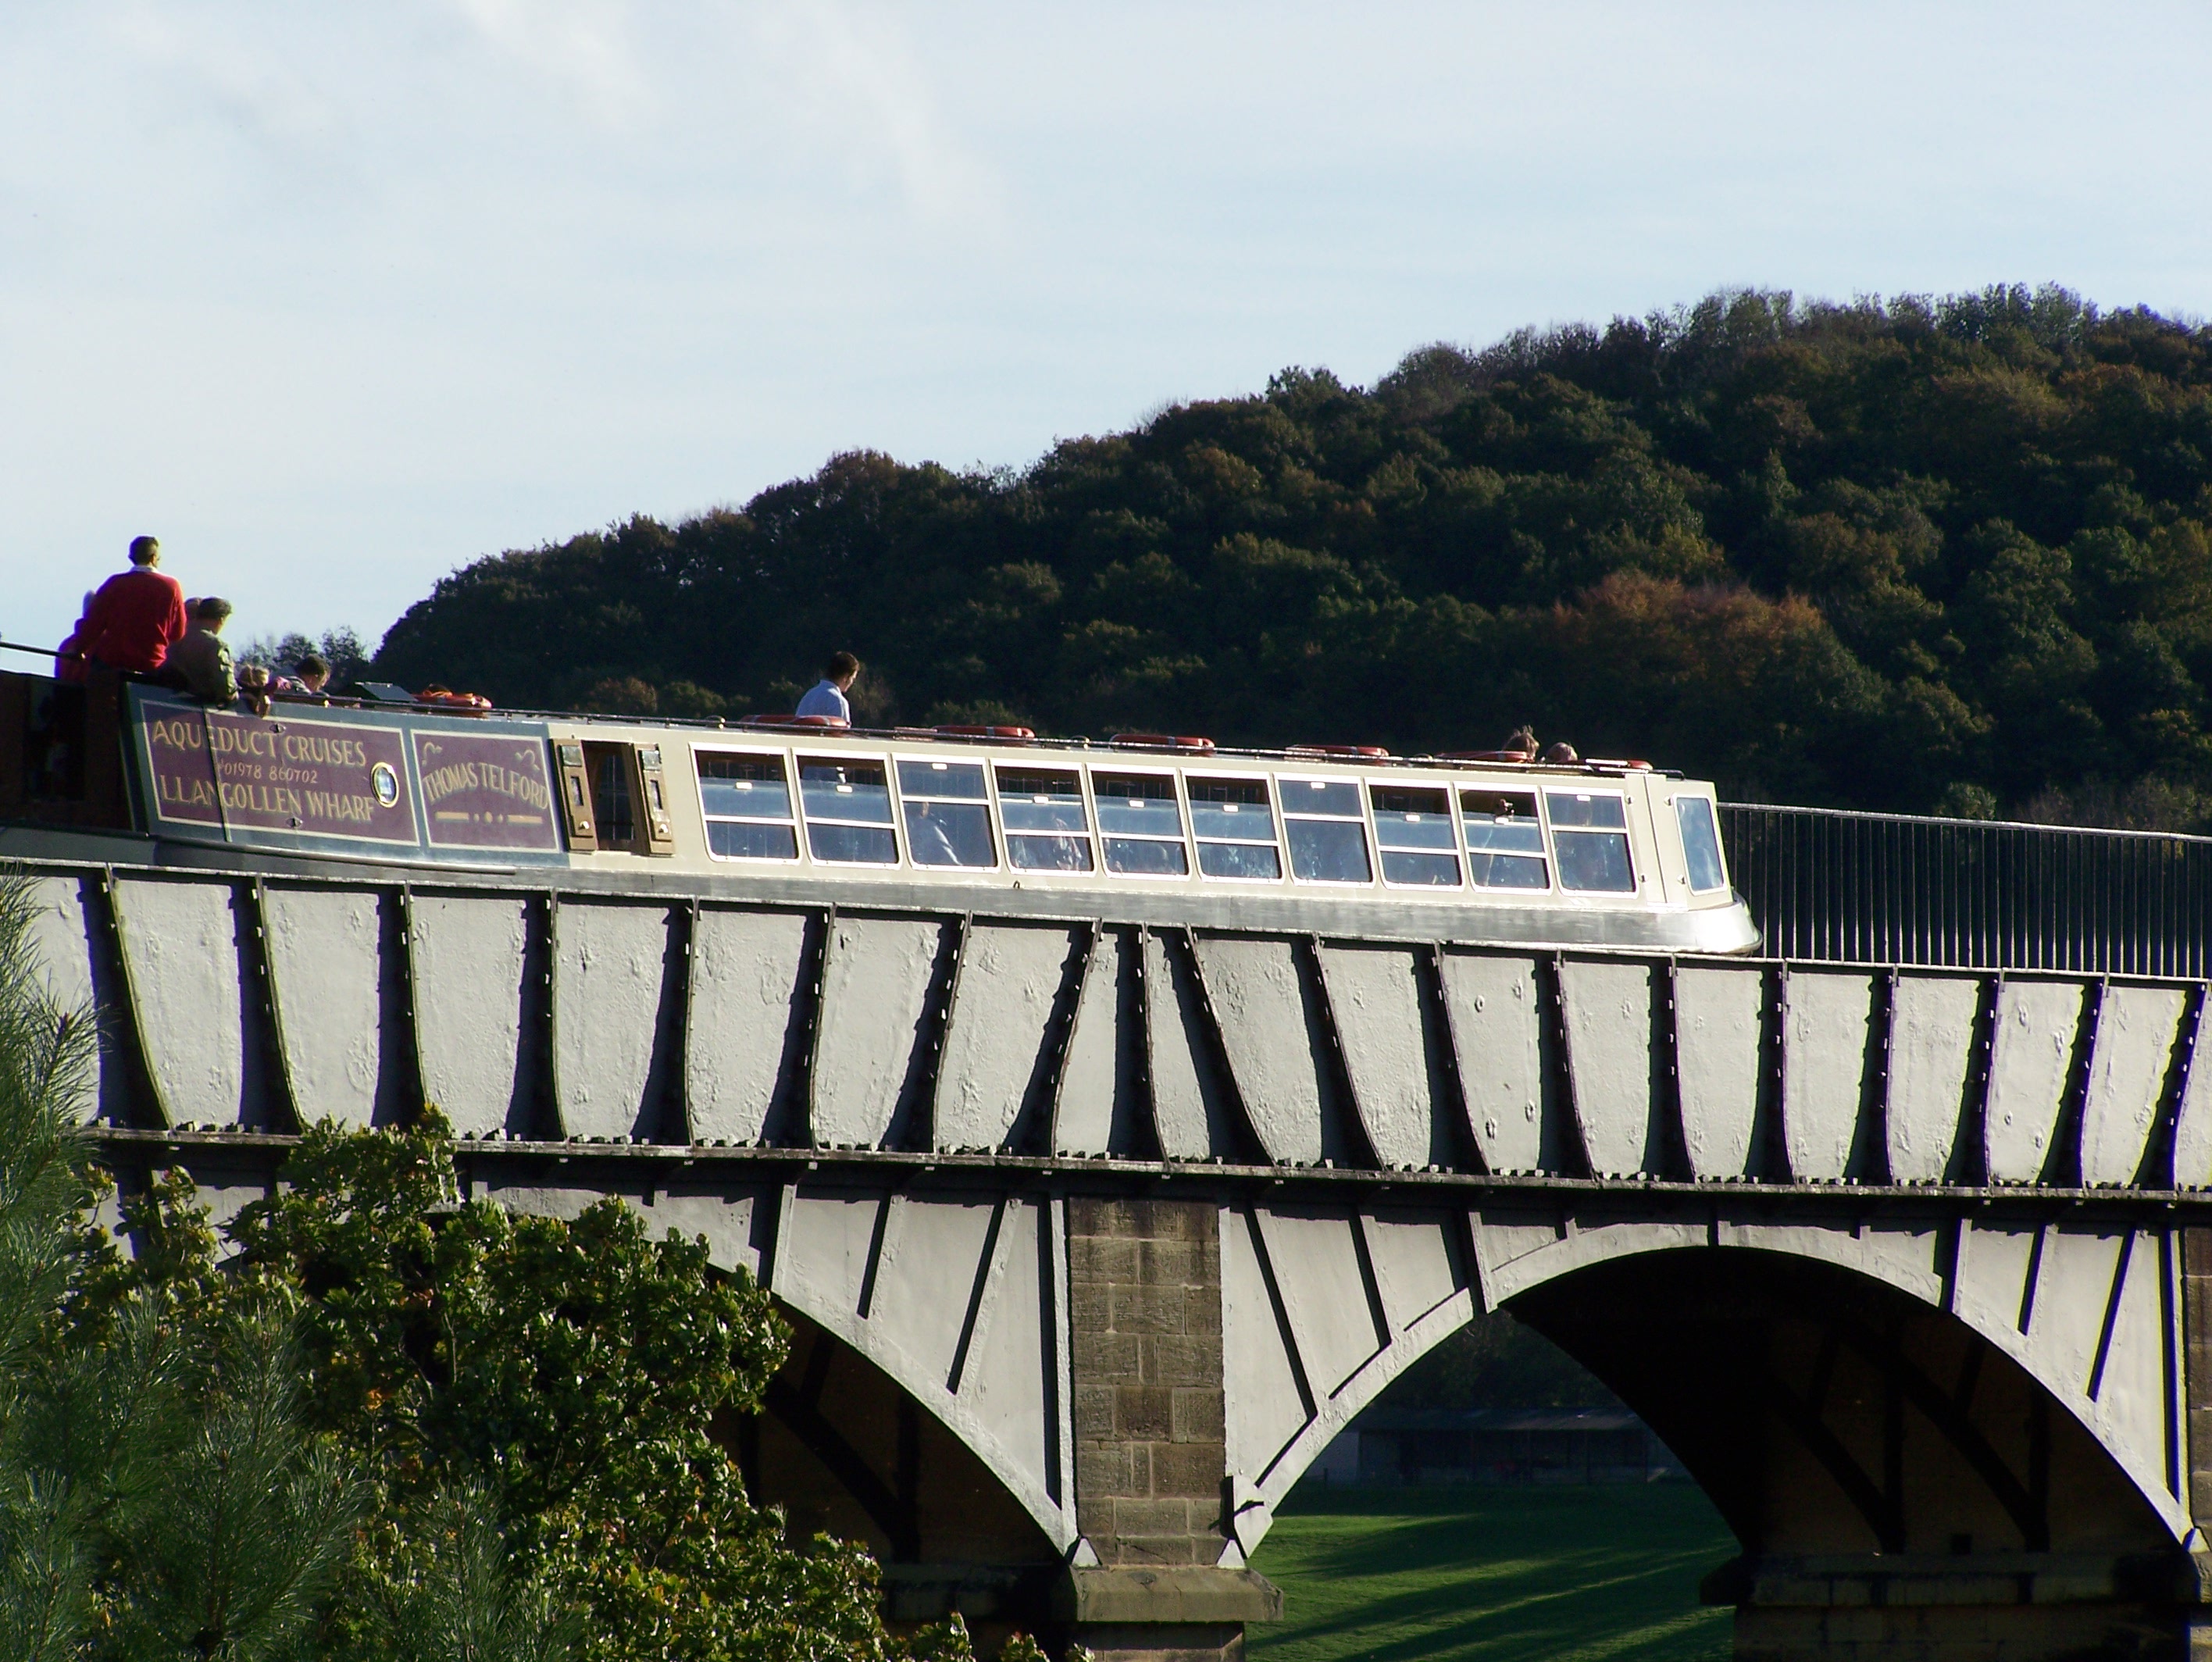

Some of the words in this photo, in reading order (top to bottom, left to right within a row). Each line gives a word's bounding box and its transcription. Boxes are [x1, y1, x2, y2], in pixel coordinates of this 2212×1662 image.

[284, 734, 366, 767] CRUISES
[269, 765, 317, 783] 860702
[423, 761, 479, 805] THOMAS
[478, 761, 548, 809] TELFORD
[305, 789, 375, 821] WHARF
